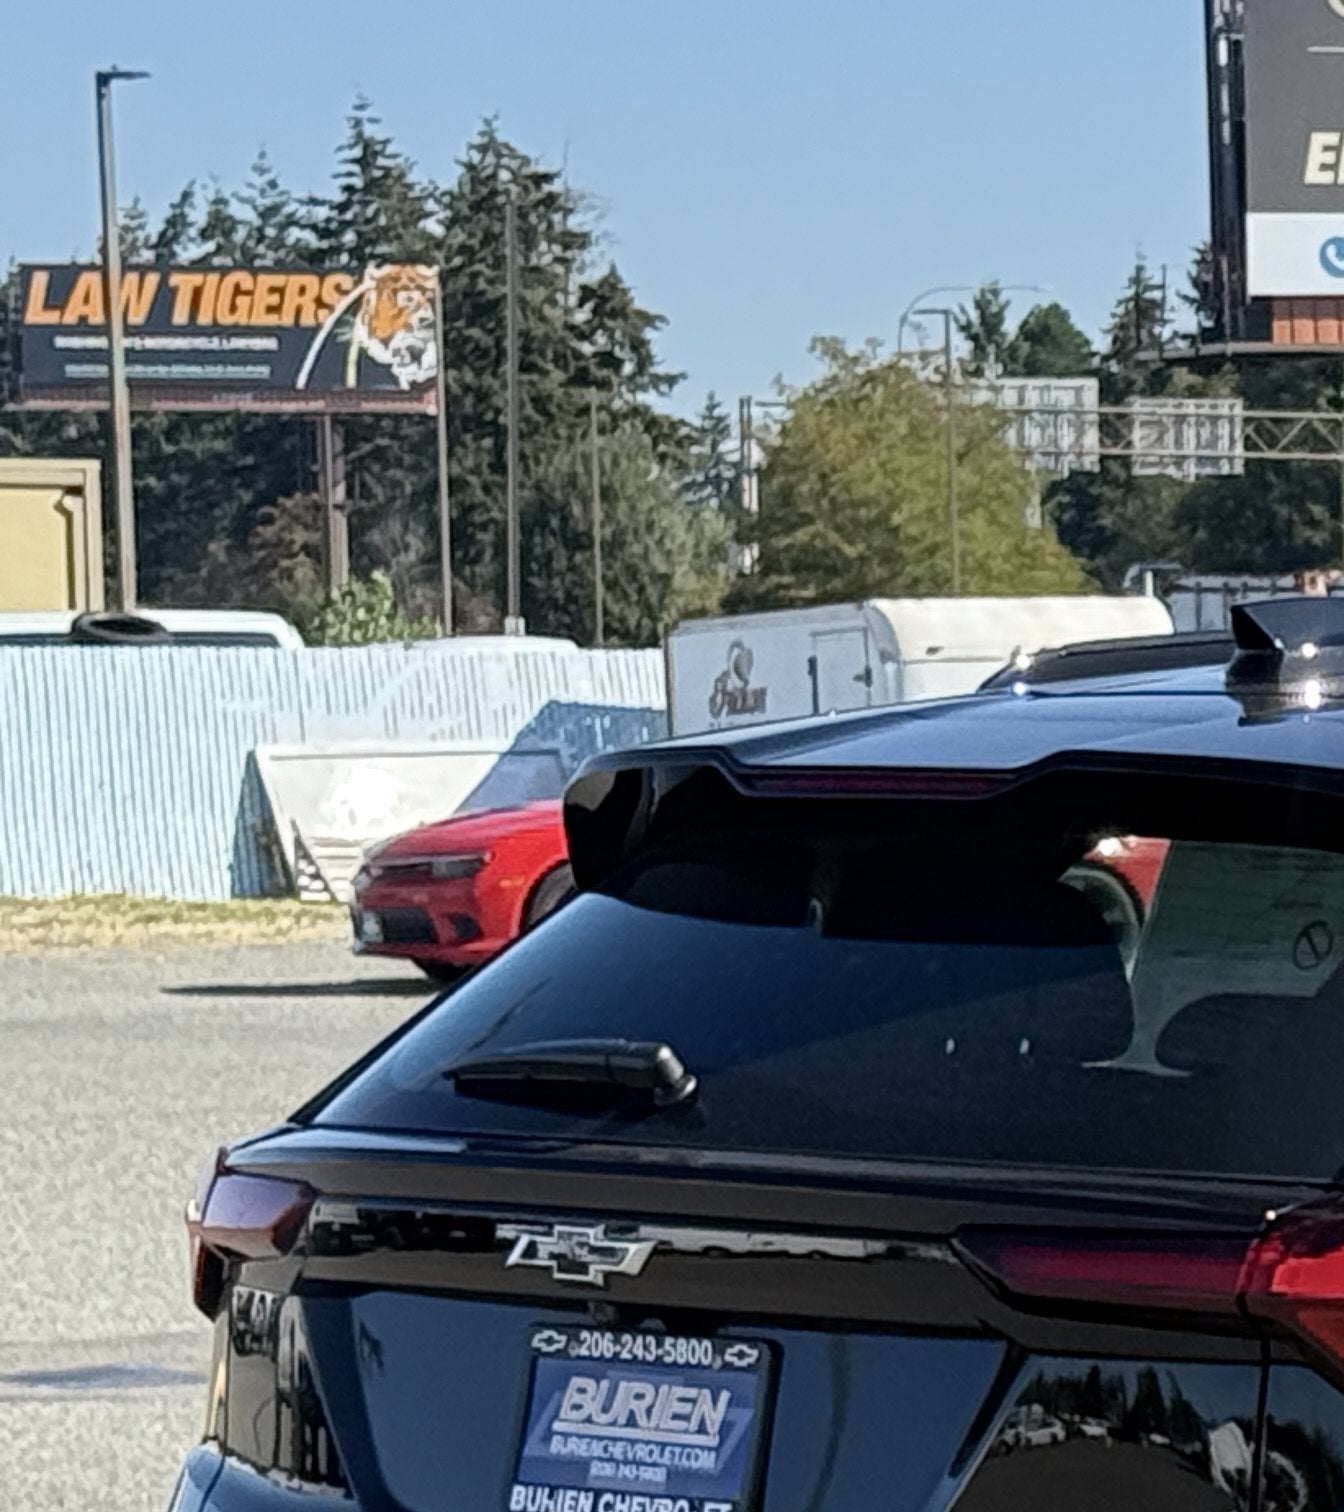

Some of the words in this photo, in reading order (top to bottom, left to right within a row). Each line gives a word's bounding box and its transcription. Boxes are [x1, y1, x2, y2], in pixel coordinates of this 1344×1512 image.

[24, 270, 161, 326] LAW
[168, 270, 354, 327] TIGERS
[579, 1331, 712, 1366] 206-243-5800
[559, 1376, 731, 1435] BURIEN
